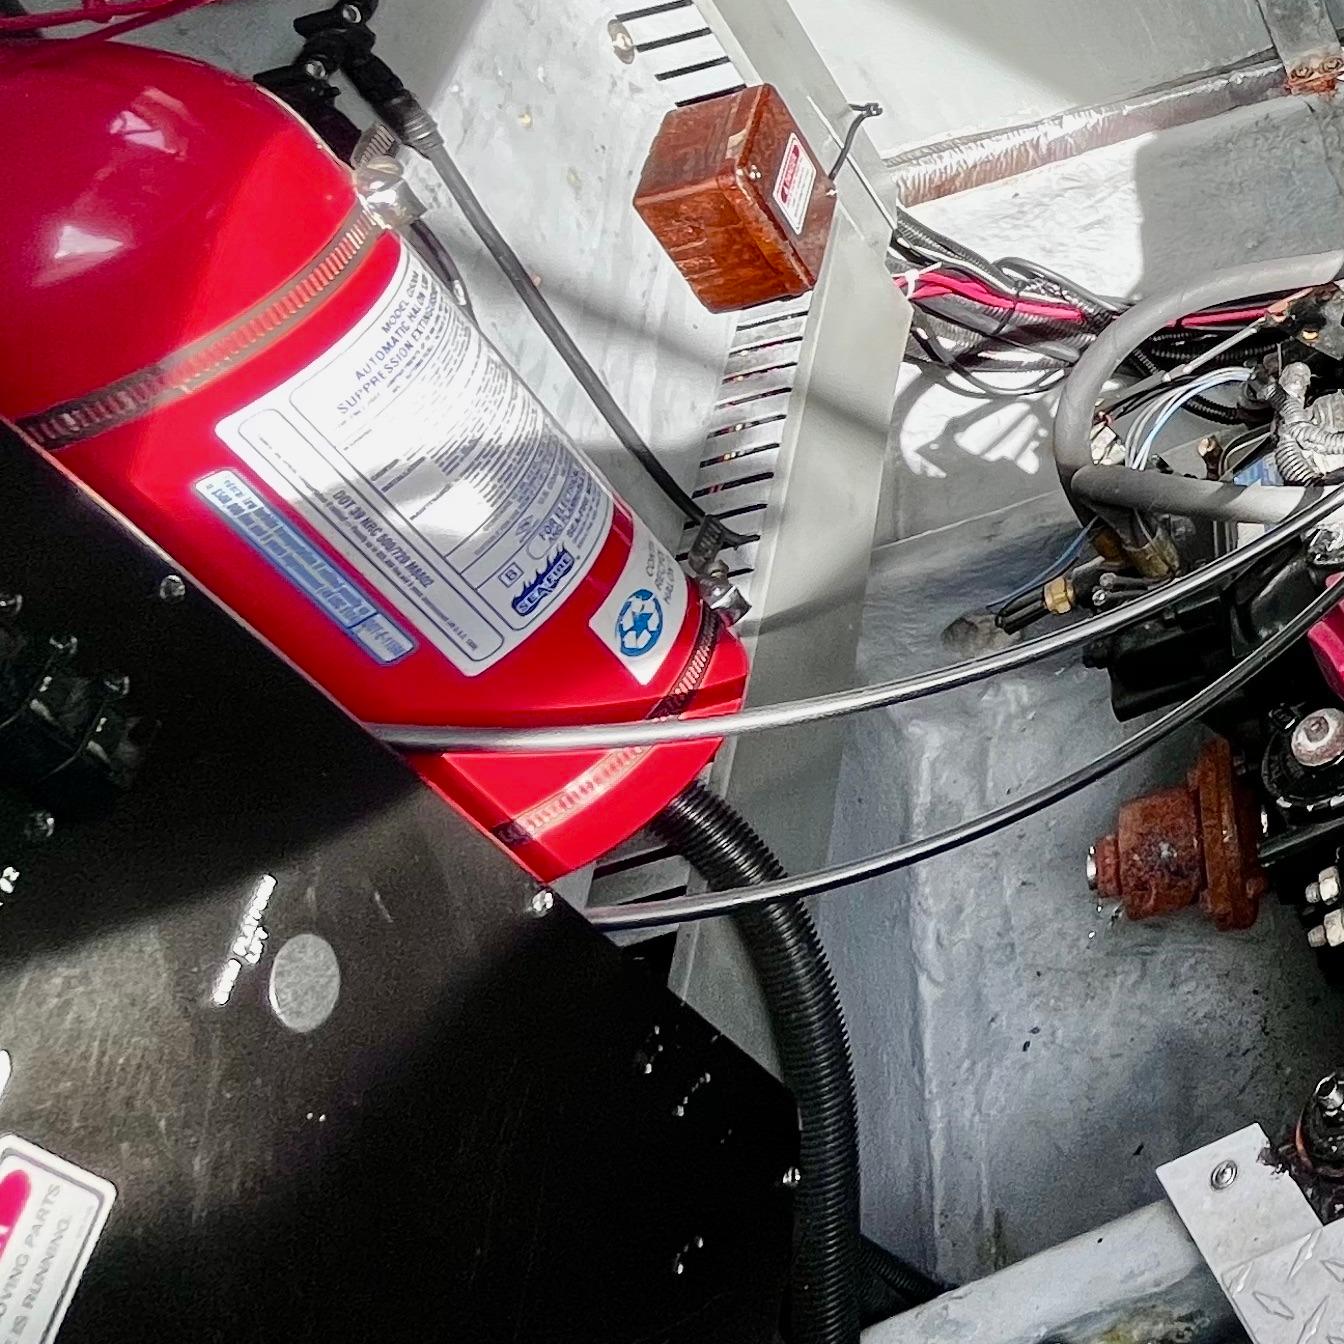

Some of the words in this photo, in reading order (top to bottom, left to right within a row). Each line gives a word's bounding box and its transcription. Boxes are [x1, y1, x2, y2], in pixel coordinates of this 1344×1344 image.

[380, 297, 410, 334] MODEL
[337, 340, 414, 415] SUPPRESSION
[354, 320, 411, 381] AUTOMATIC
[24, 1183, 61, 1247] PARTS
